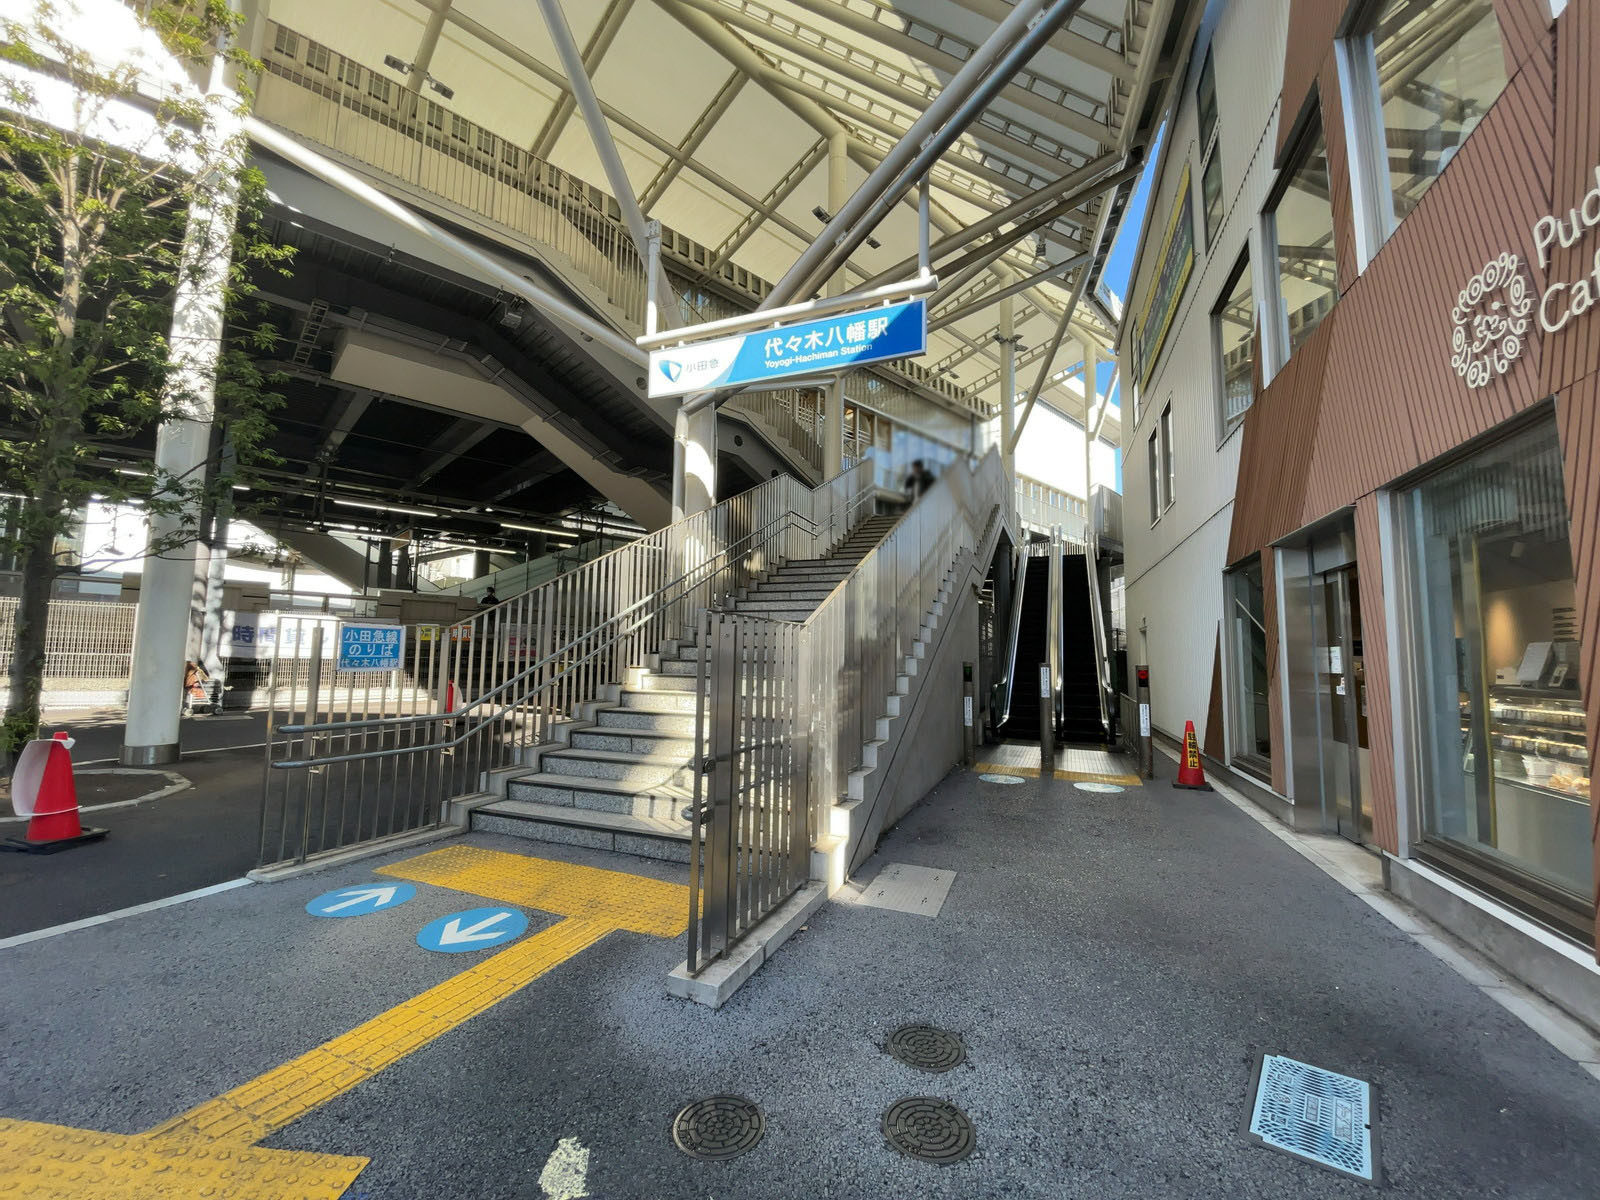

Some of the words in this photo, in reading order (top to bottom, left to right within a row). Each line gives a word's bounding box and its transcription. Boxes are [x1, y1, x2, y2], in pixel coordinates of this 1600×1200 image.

[764, 316, 889, 359] 代々木八幡駅
[764, 349, 839, 369] Yoyogi-Hachiman
[840, 343, 873, 356] Station
[345, 629, 398, 644] 小田急線
[348, 643, 394, 656] のりば
[341, 657, 399, 667] 代々木八幡駅
